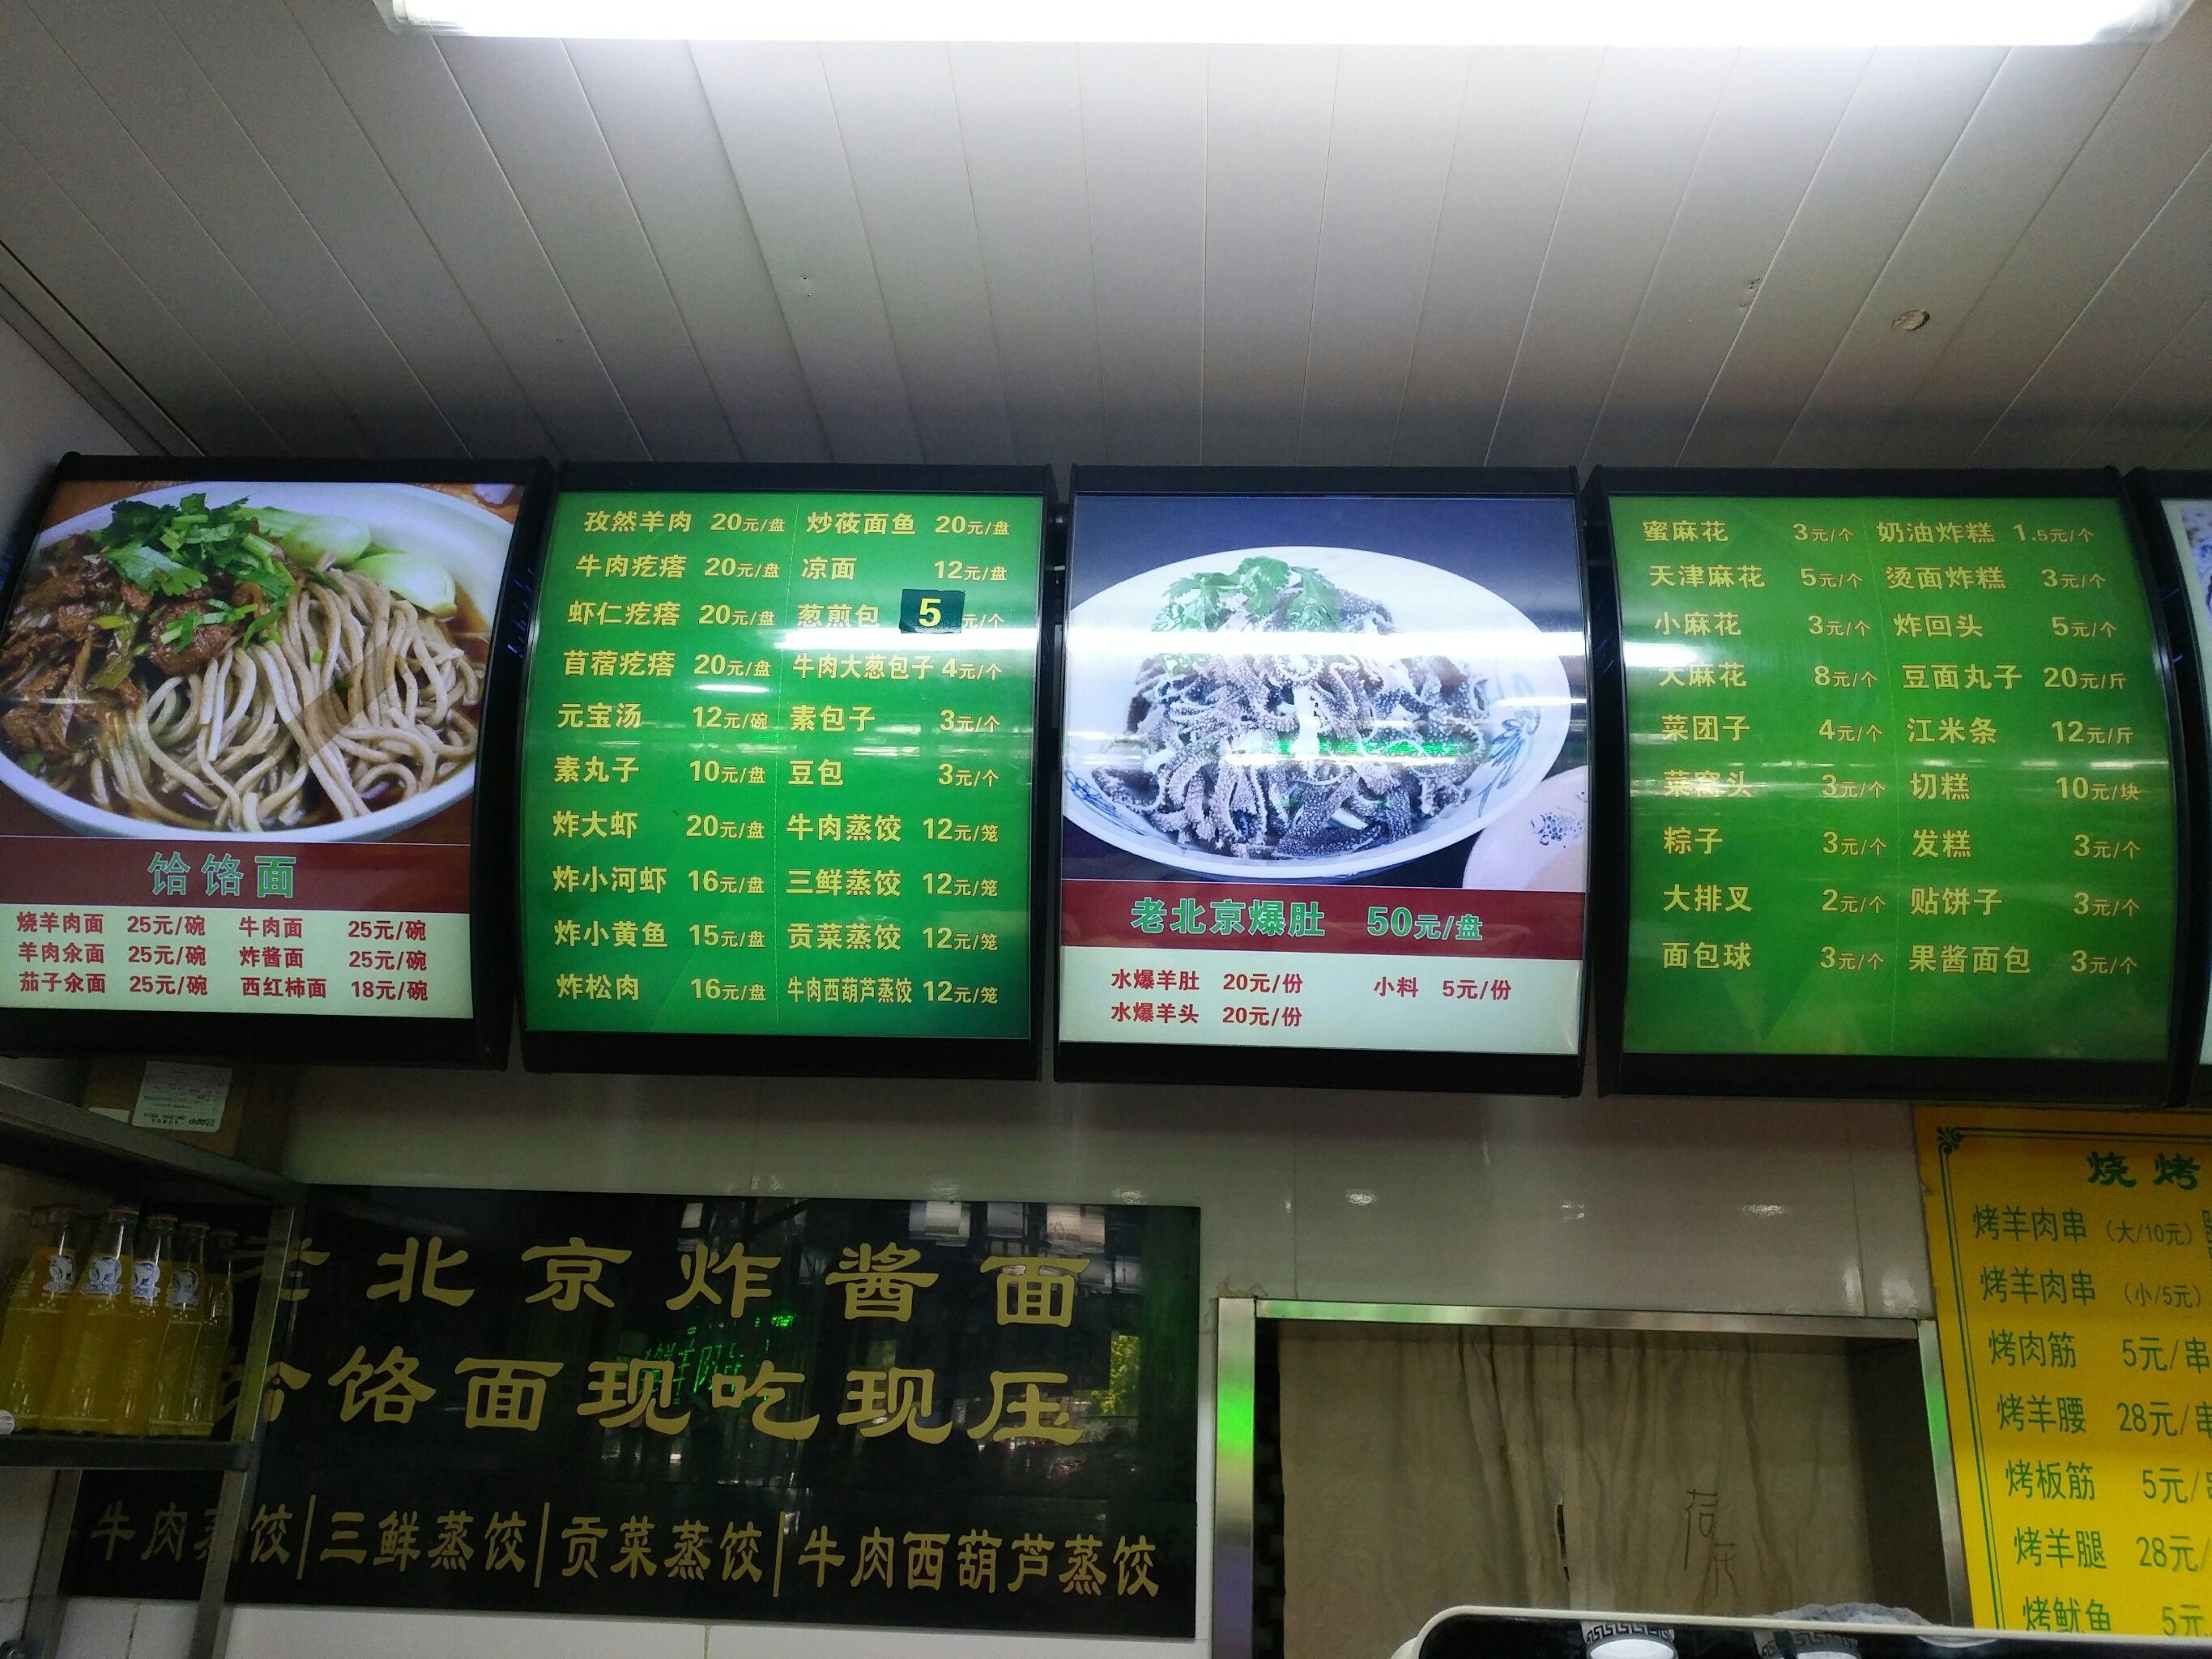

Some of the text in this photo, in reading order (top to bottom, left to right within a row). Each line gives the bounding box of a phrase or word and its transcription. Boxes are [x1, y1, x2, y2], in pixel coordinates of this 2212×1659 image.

[584, 510, 786, 533] 孜然羊肉 20元/盘
[806, 511, 1011, 536] 炒莜面鱼 20元/盘
[1643, 520, 1855, 544] 蜜麻花 3元/个
[1876, 521, 2094, 545] 奶油炸糕 1.5元/个
[576, 554, 781, 578] 牛肉疙瘩 20元/盘
[801, 557, 1008, 582] 凉面 12元/盘
[1648, 565, 1864, 589] 天津麻花 5元/个
[1885, 565, 2107, 591] 烫面炸糕 3元/个
[567, 600, 776, 626] 虾仁疙瘩 20元/盘
[798, 603, 880, 629] 葱煎包
[1654, 612, 1871, 638] 小麻花 3元/个
[1893, 614, 2118, 640] 炸回头 5元/个
[563, 650, 772, 677] 苜蓿疙瘩 20元/盘
[793, 653, 1002, 680] 牛肉大葱包子 4元/个
[1657, 662, 1878, 689] 大麻花 8元/个
[1902, 664, 2127, 691] 豆面丸子 20元/斤
[557, 702, 769, 731] 元宝汤 12元/碗
[790, 705, 1001, 733] 素包子 3元/个
[1661, 714, 1883, 744] 菜团子 4元/个
[1907, 716, 2134, 745] 江米条 12元/斤
[554, 756, 766, 785] 素丸子 10元/盘
[788, 760, 999, 788] 豆包 3元/个
[1821, 774, 1886, 800] 3元/个
[1910, 772, 2141, 803] 切糕 10元/块
[552, 810, 765, 840] 炸大虾 20元/盘
[786, 813, 999, 843] 牛肉蒸饺 12元/笼
[1663, 827, 1887, 857] 粽子 3元/个
[1911, 829, 2142, 860] 发糕 3元/个
[147, 851, 296, 898] 饸饹面
[552, 865, 765, 895] 炸小河虾 16元/盘
[786, 868, 999, 898] 三鲜蒸饺 12元/笼
[1662, 884, 1886, 915] 大排叉 2元/个
[1910, 887, 2140, 918] 贴饼子 3元/个
[17, 911, 206, 936] 烧羊肉面 25元/碗
[239, 917, 426, 941] 牛肉面 25元/碗
[1131, 898, 1484, 941] 老北京爆肚 50元/盘
[553, 920, 766, 949] 炸小黄鱼 15元/盘
[786, 923, 999, 952] 贡菜蒸饺 12元/笼
[128, 945, 207, 966] 25元/碗
[240, 947, 427, 972] 炸酱面 25元/碗
[1662, 941, 1885, 972] 面包球 3元/个
[1908, 945, 2137, 975] 果酱面包 3元/个
[130, 975, 207, 996] 25元/碗
[241, 977, 428, 1002] 西红柿面 18元/碗
[556, 973, 767, 1002] 炸松肉 16元/盘
[787, 976, 999, 1004] 牛肉西葫芦蒸饺 12元/笼
[1110, 969, 1303, 995] 水爆羊肚 20元/份
[1374, 976, 1512, 1001] 小料 5元/份
[1110, 1002, 1302, 1028] 水爆羊头 20元/份
[2086, 1150, 2201, 1191] 烧烤
[1973, 1205, 2088, 1243] 烤羊肉串
[1980, 1266, 2095, 1307] 烤羊肉串
[1988, 1330, 2210, 1374] 烤肉筋 5元/串
[1997, 1394, 2087, 1435] 烤羊腰
[2005, 1460, 2212, 1503] 烤板筋 5元/
[320, 1510, 526, 1573] 三鲜蒸饺
[560, 1516, 763, 1584] 贡菜蒸饺
[798, 1525, 1160, 1597] 牛肉西葫芦蒸饺
[2014, 1527, 2107, 1569] 烤羊腿
[2022, 1595, 2111, 1634] 烤鱿鱼
